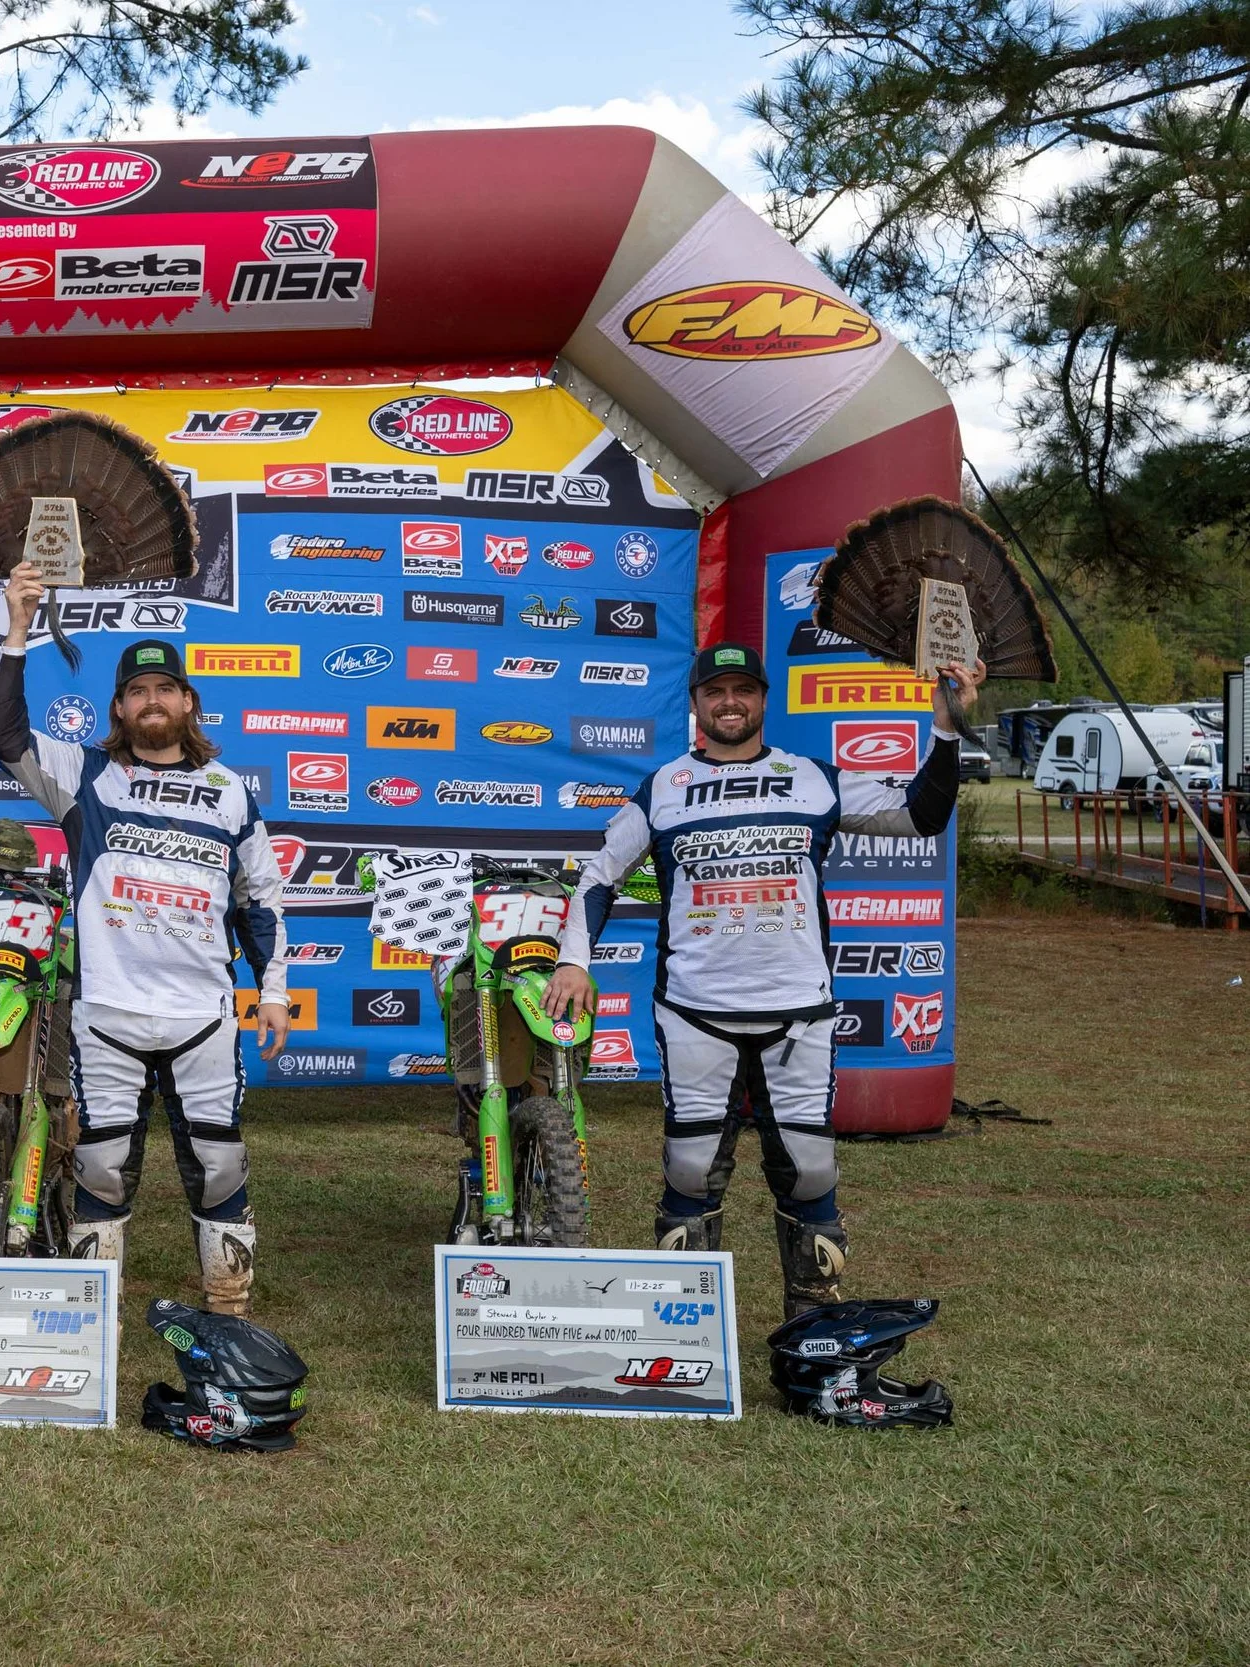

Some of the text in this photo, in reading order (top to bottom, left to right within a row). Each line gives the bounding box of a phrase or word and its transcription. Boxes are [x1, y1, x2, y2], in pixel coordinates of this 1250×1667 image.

[35, 162, 141, 182] RED LINE
[50, 181, 125, 190] SYNTHETIC OIL
[60, 222, 77, 239] By
[61, 253, 201, 280] Beta
[61, 281, 200, 297] motorcycles
[231, 263, 364, 303] MSR
[630, 292, 870, 344] FMF
[411, 413, 500, 433] RED LINE
[330, 467, 437, 485] Beta
[333, 485, 438, 498] motorcycles
[466, 472, 554, 501] MSR
[289, 536, 346, 549] Enduro
[621, 532, 652, 548] SEAT
[291, 546, 385, 562] Engineering
[484, 538, 529, 565] XC
[556, 549, 591, 561] RED LINE
[404, 558, 462, 570] Beta
[617, 550, 657, 577] CONCEPTS
[404, 569, 461, 577] motorcycles
[284, 591, 376, 602] ROCKY MOUNTAIN
[429, 598, 497, 617] Husqvarna
[194, 649, 292, 672] PIRELLI
[425, 669, 459, 678] GASGAS
[584, 665, 624, 681] MSR
[54, 698, 90, 715] SEAT
[48, 715, 94, 742] CONCEPTS
[382, 718, 440, 739] KTM
[481, 722, 554, 740] FMF
[594, 726, 645, 743] YAMAHA
[130, 780, 222, 810] MSR
[383, 786, 418, 797] RED LINE
[453, 782, 535, 793] ROCKY MOUNTAIN
[575, 784, 624, 796] Enduro
[684, 777, 793, 808] MSR
[290, 792, 348, 803] Beta
[290, 803, 348, 812] motorcycles
[125, 825, 223, 855] ROCKY MOUNTAIN
[691, 827, 804, 844] ROCKY MOUNTAIN
[838, 832, 937, 857] YAMAHA
[681, 857, 804, 881] Kawasaki
[421, 880, 442, 890] SHOEI
[692, 878, 798, 907] PIRELLI
[113, 875, 211, 913] PIRELLI
[385, 889, 406, 901] SHOEI
[408, 900, 429, 910] SHOEI
[479, 894, 572, 942] 36
[295, 1055, 356, 1070] YAMAHA
[700, 1271, 709, 1294] 0003
[84, 1280, 93, 1303] 0001
[457, 1325, 638, 1342] FOUR HUNDRED TWENTY FIVE and 00/100
[805, 1343, 836, 1354] SHOEI
